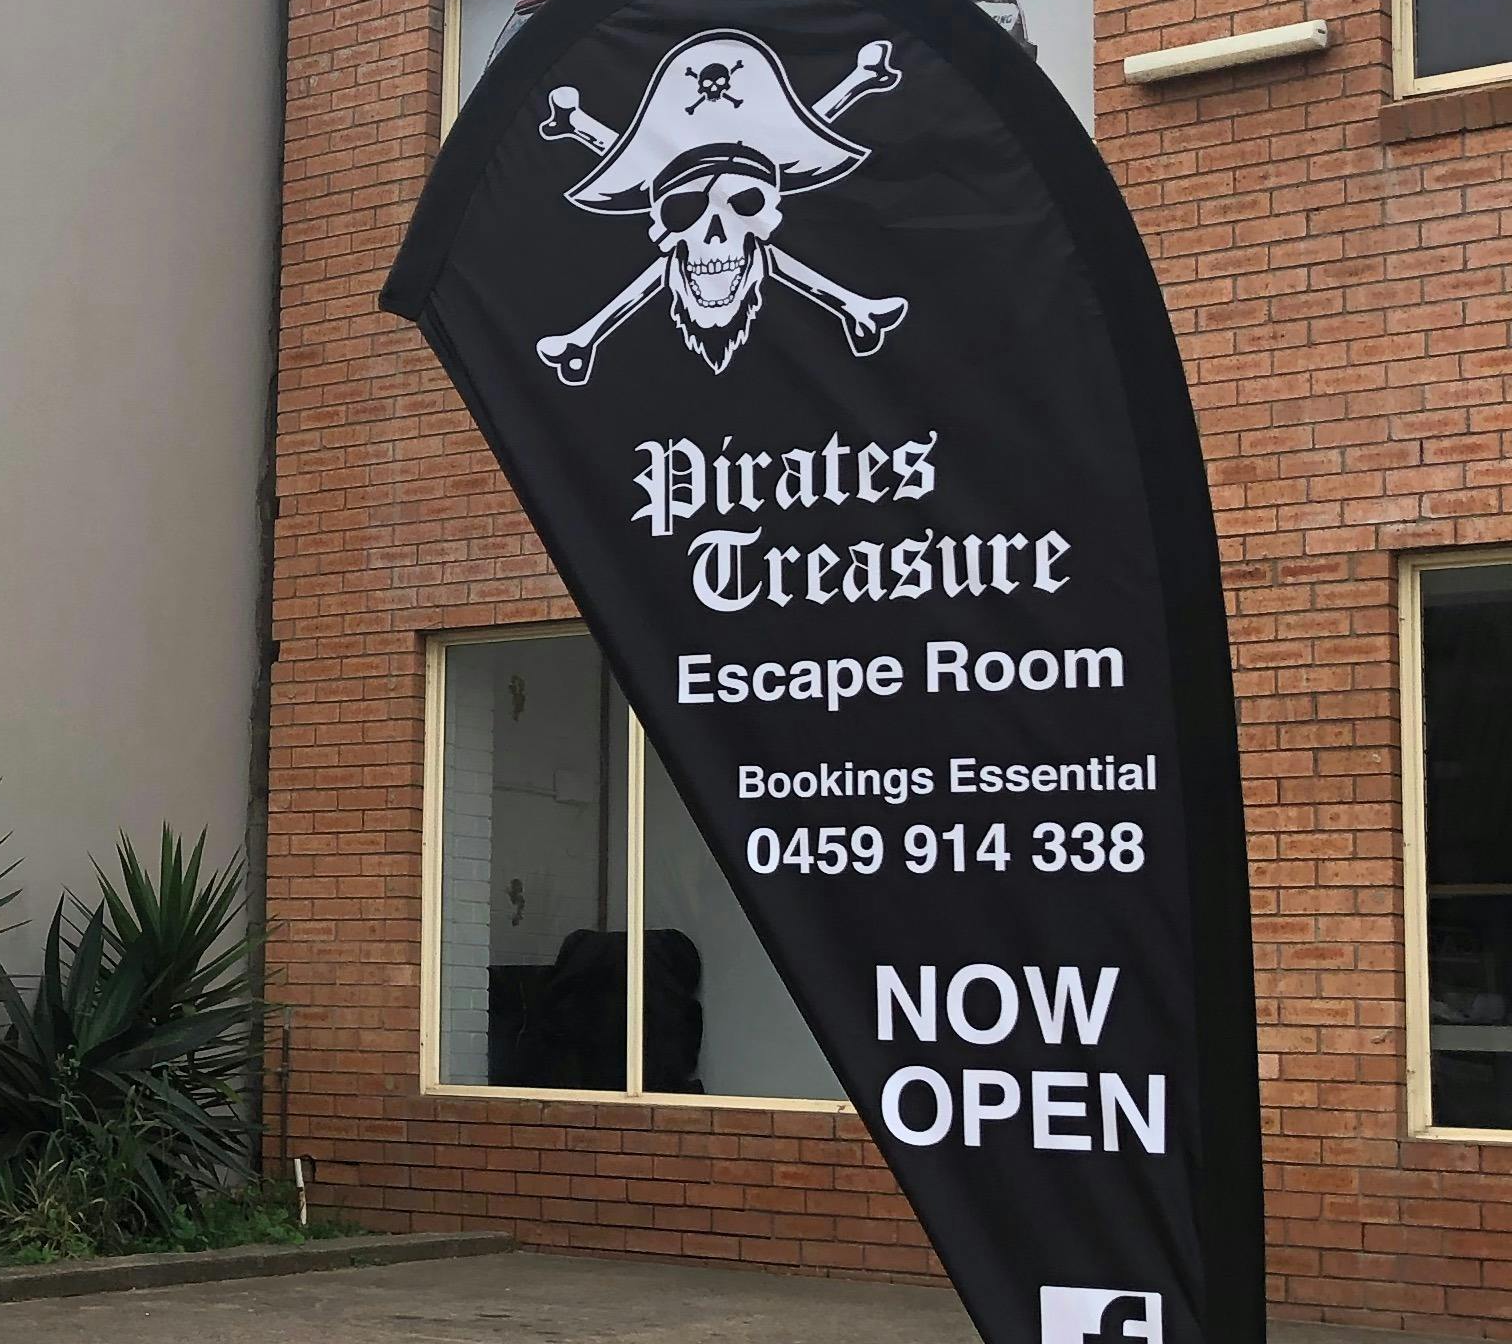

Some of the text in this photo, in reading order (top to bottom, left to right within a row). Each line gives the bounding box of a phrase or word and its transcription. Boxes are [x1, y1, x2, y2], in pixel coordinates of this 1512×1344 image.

[630, 430, 938, 537] Pirates
[688, 527, 1071, 612] Treasure
[677, 639, 1125, 712] Escape Room
[738, 755, 1157, 804] Bookings Essential
[747, 821, 1145, 874] 0459 914 338
[875, 963, 1120, 1046] NOW
[880, 1065, 1166, 1154] OPEN
